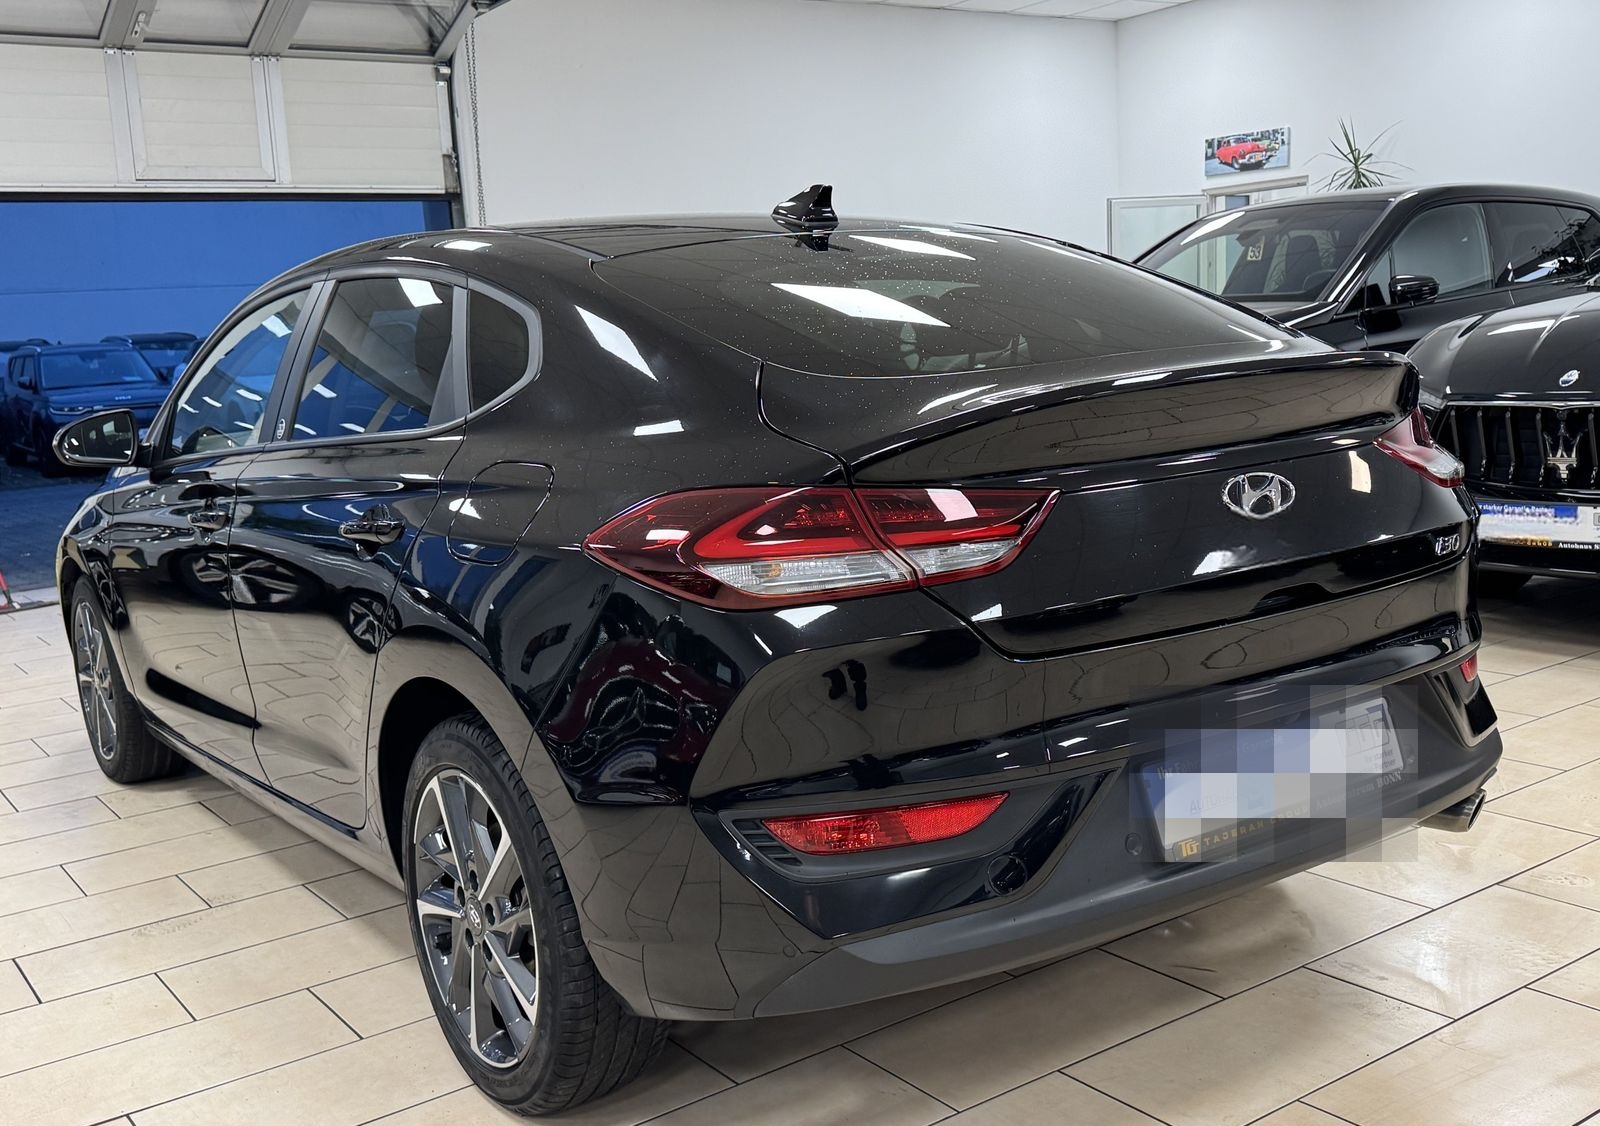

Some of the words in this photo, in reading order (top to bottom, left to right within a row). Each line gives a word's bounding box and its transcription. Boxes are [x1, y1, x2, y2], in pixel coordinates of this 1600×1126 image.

[1558, 542, 1592, 550] Autohaus
[1203, 819, 1265, 847] TAJERAN
[1377, 771, 1403, 788] BONN
